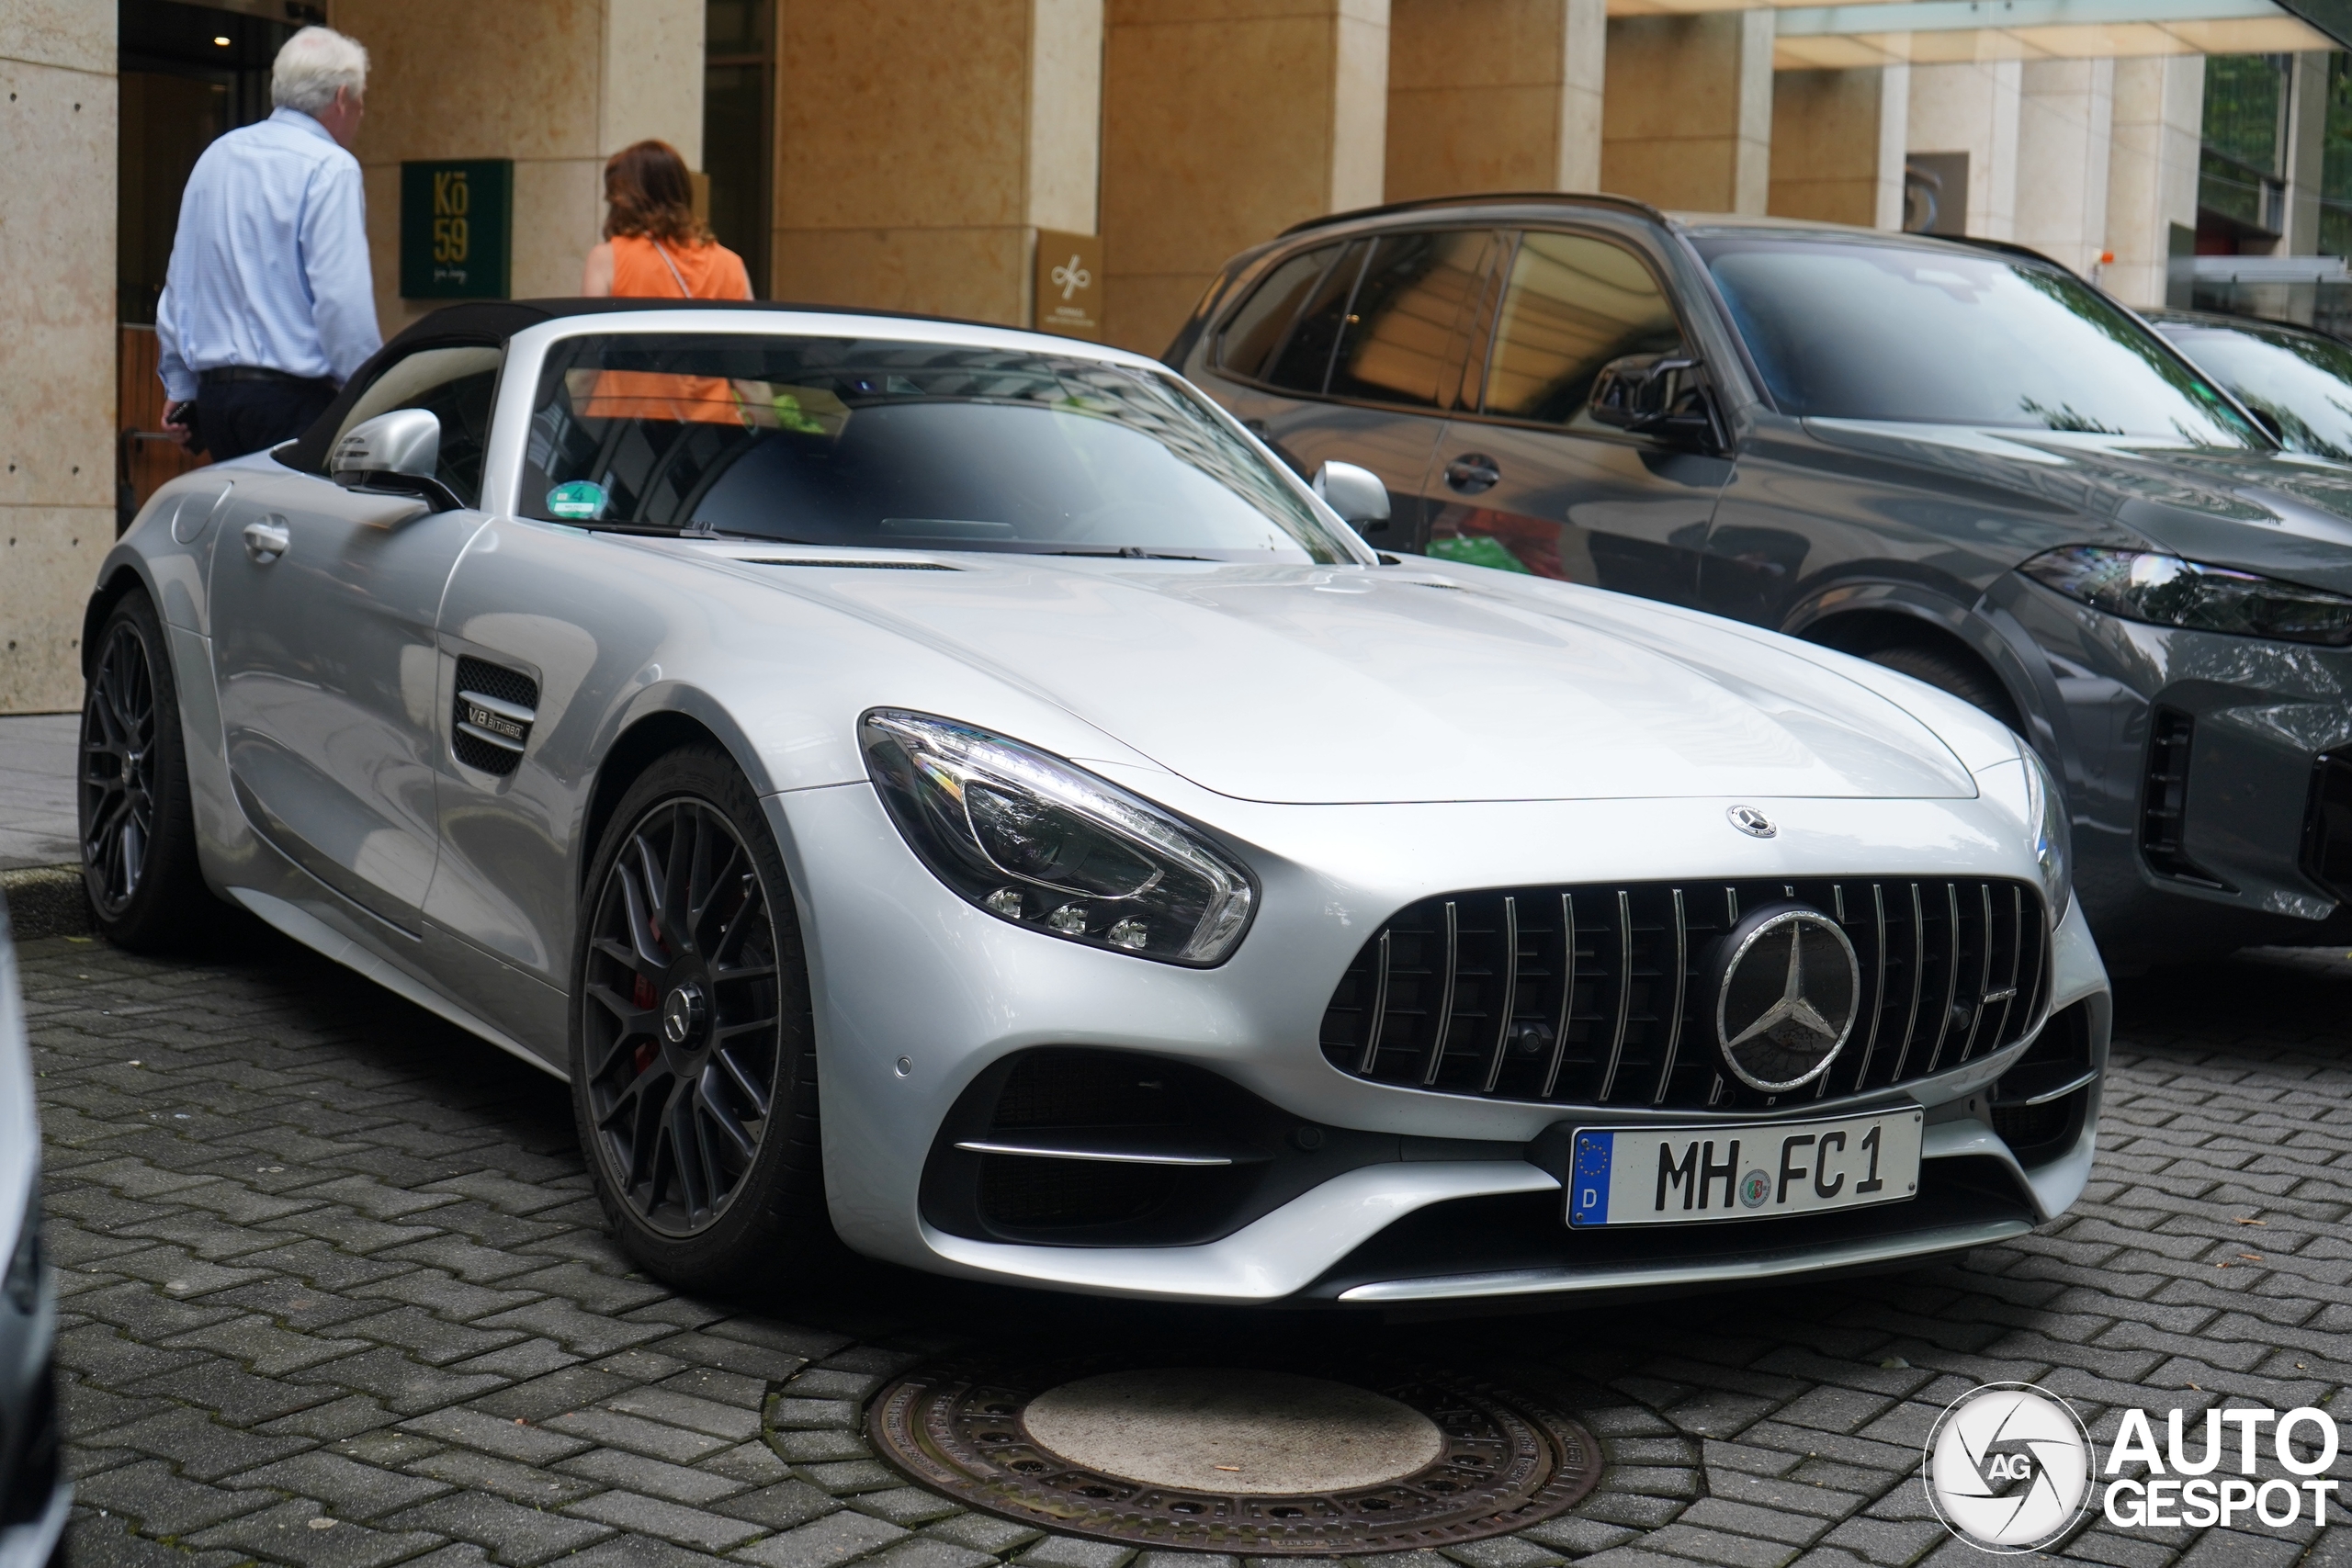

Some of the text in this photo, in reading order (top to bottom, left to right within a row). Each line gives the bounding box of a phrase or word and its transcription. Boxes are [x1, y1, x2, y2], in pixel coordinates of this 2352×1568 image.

[433, 217, 469, 264] 59
[570, 486, 585, 502] 4
[469, 706, 522, 738] V8 BITURBO
[1655, 1139, 1741, 1212] MH
[1776, 1131, 1848, 1204] FC
[1855, 1124, 1884, 1195] 1
[1581, 1188, 1598, 1209] D
